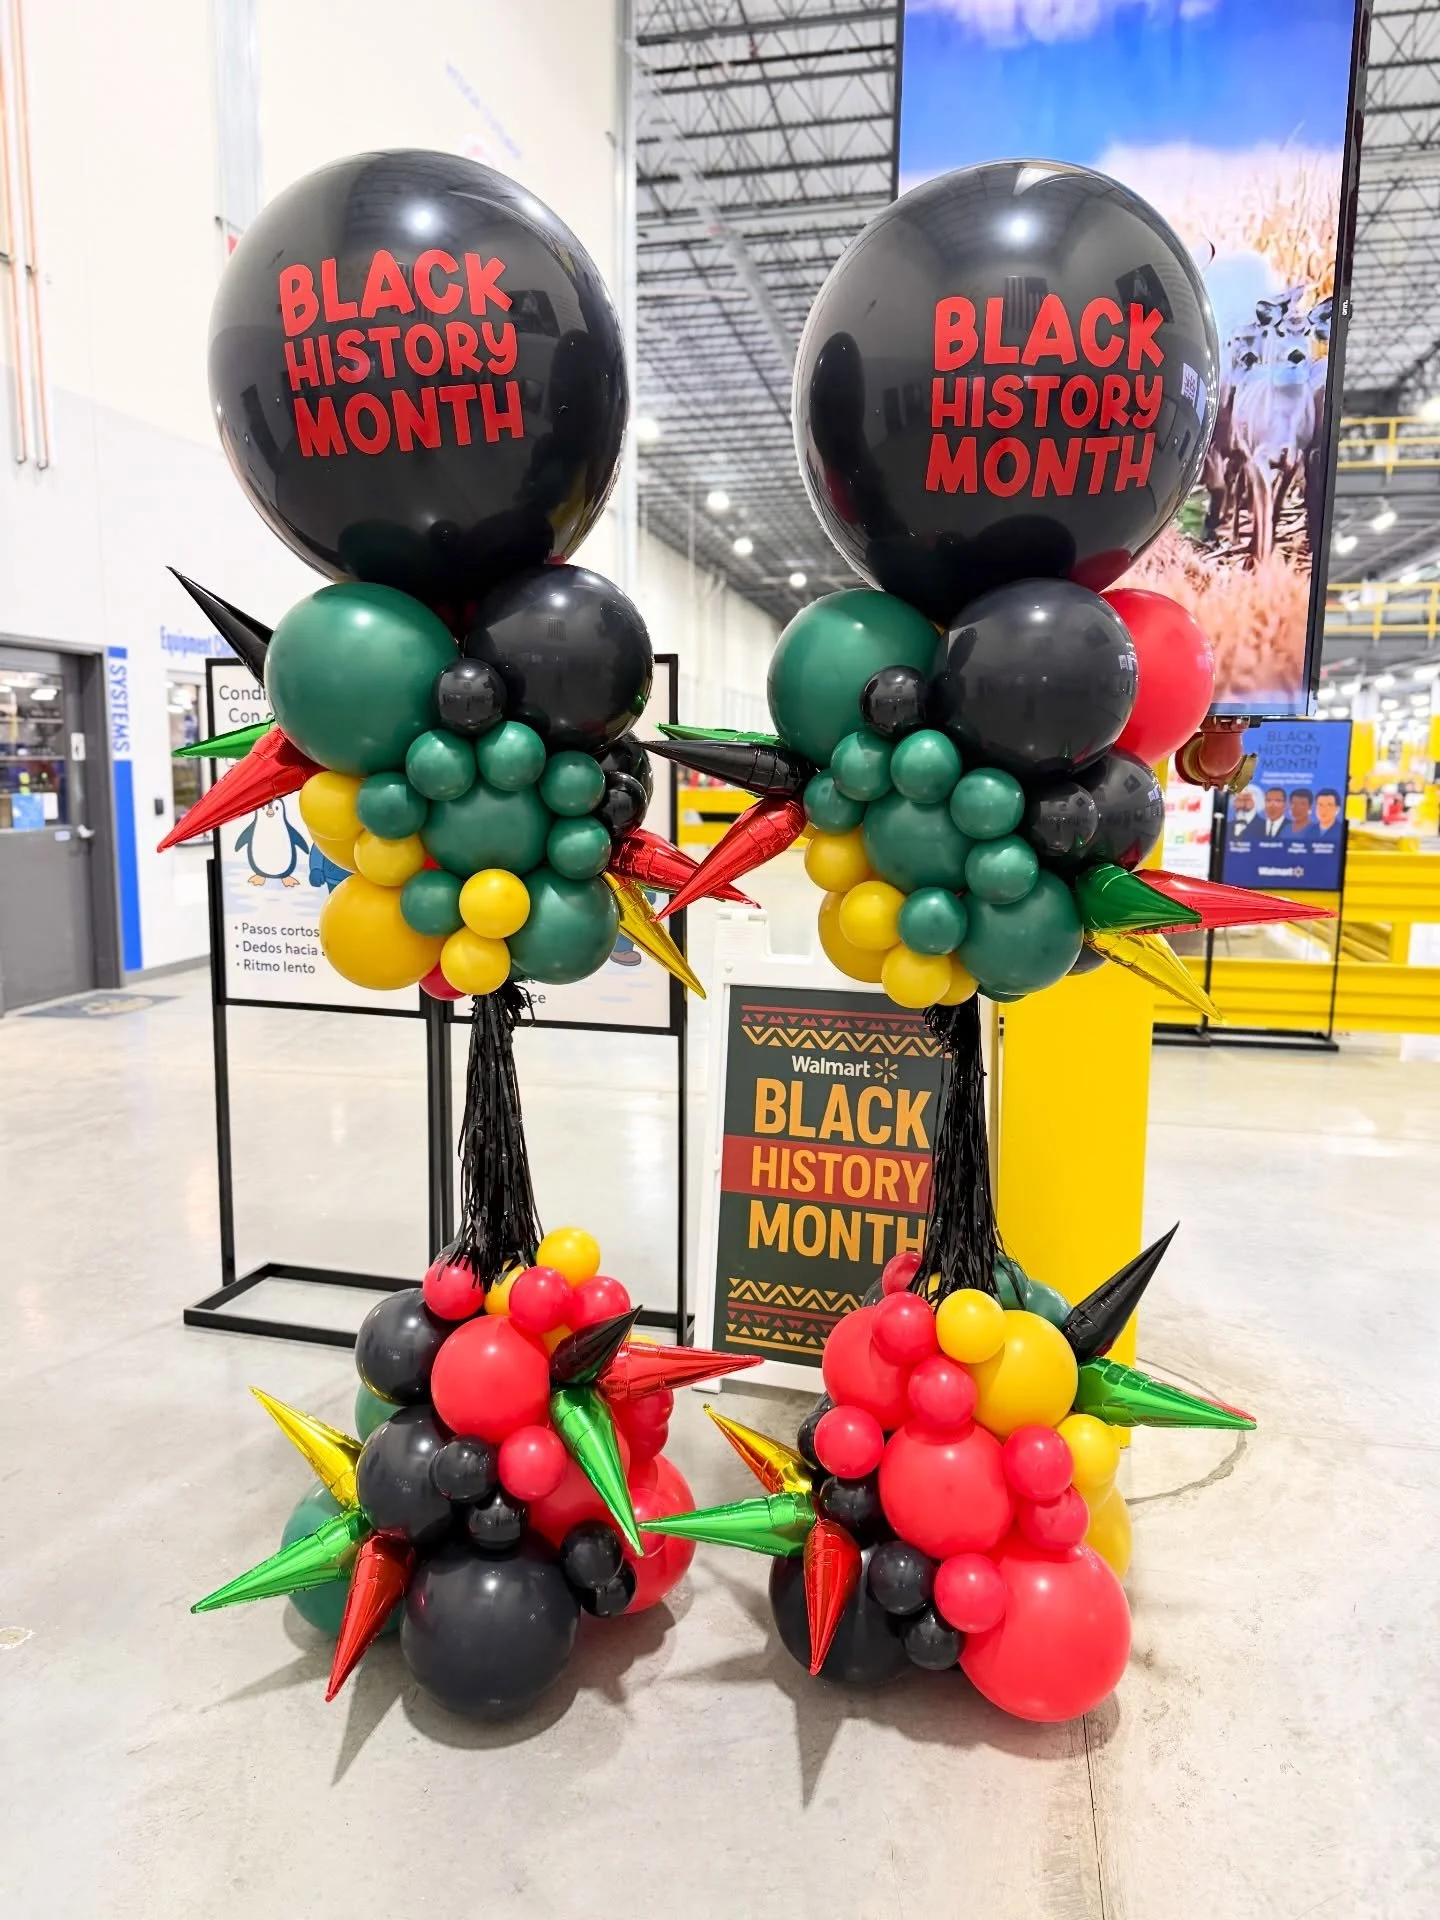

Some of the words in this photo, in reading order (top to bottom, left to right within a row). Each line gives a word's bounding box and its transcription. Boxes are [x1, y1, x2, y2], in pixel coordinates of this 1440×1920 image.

[279, 249, 513, 337] BLACK
[284, 321, 518, 392] HISTORY
[934, 294, 1164, 371] BLACK
[293, 381, 524, 457] MONTH
[931, 374, 1163, 429] HISTORY
[925, 432, 1156, 498] MONTH
[110, 664, 130, 752] SYSTEMS
[228, 707, 260, 723] Con
[1266, 730, 1317, 742] BLACK
[1258, 743, 1322, 756] HISTORY
[1261, 758, 1318, 770] MONTH
[242, 922, 278, 935] Pasos
[280, 926, 320, 938] cortos
[242, 940, 282, 954] Dedos
[285, 942, 319, 956] hacia
[243, 959, 280, 972] Ritmo
[283, 961, 316, 974] lento
[791, 1055, 871, 1078] Walmart
[754, 1077, 932, 1149] BLACK
[751, 1145, 930, 1204] HISTORY
[748, 1199, 927, 1265] MONTH
